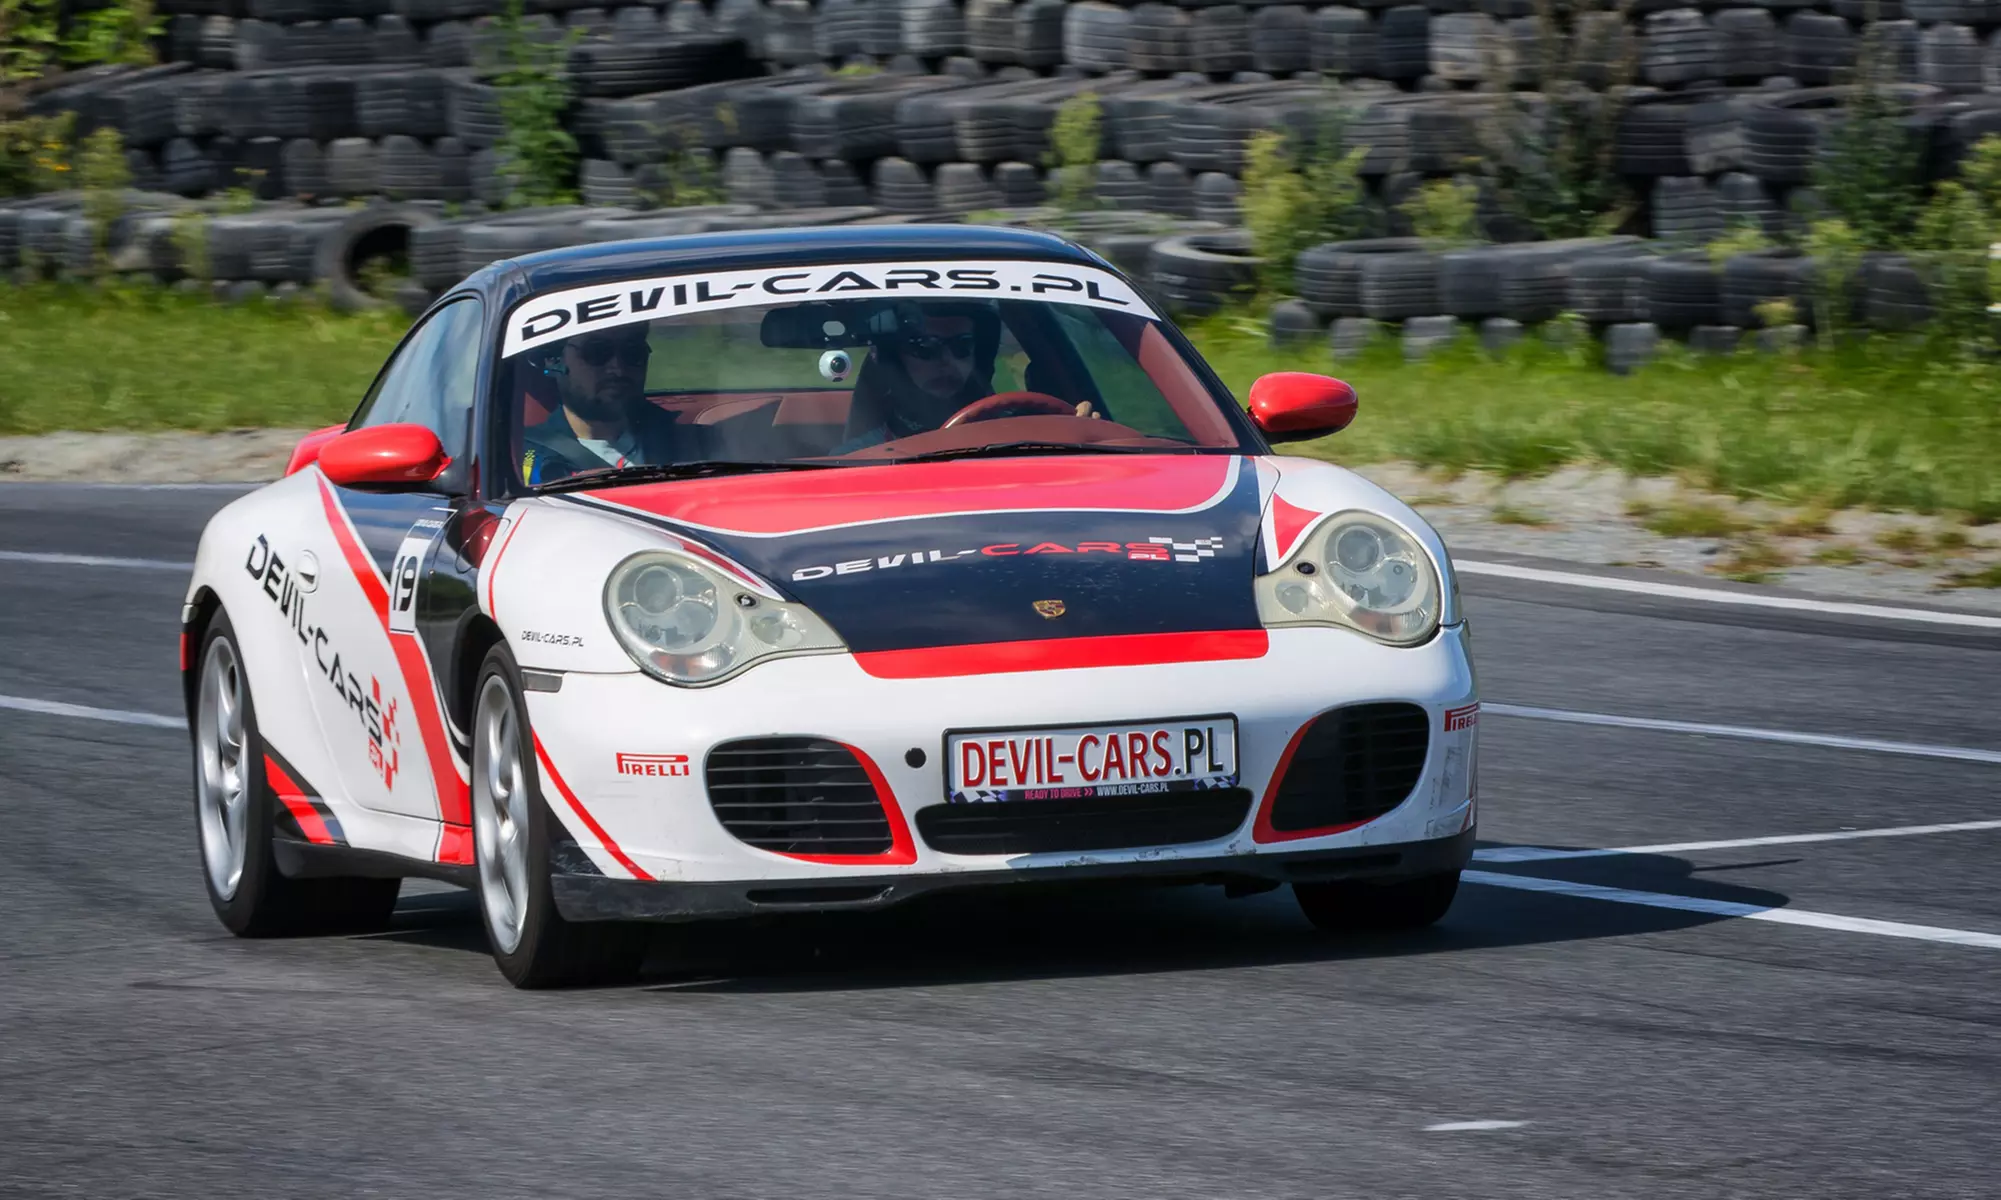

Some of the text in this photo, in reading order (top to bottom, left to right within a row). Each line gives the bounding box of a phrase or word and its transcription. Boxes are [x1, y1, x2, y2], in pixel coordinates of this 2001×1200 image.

[521, 269, 1131, 342] DEVIL-CARS.PL
[392, 555, 419, 612] 19
[792, 541, 1168, 582] DEVIL-CARS
[245, 533, 383, 747] DEVIL-CARS
[521, 630, 585, 648] DEVIL-CARS.PL
[616, 752, 690, 777] PIRELLI
[961, 727, 1224, 788] DEVIL-CARS.PL
[1024, 782, 1170, 800] READY TO DRIVE WWW.DEVIL-CARS.PL
